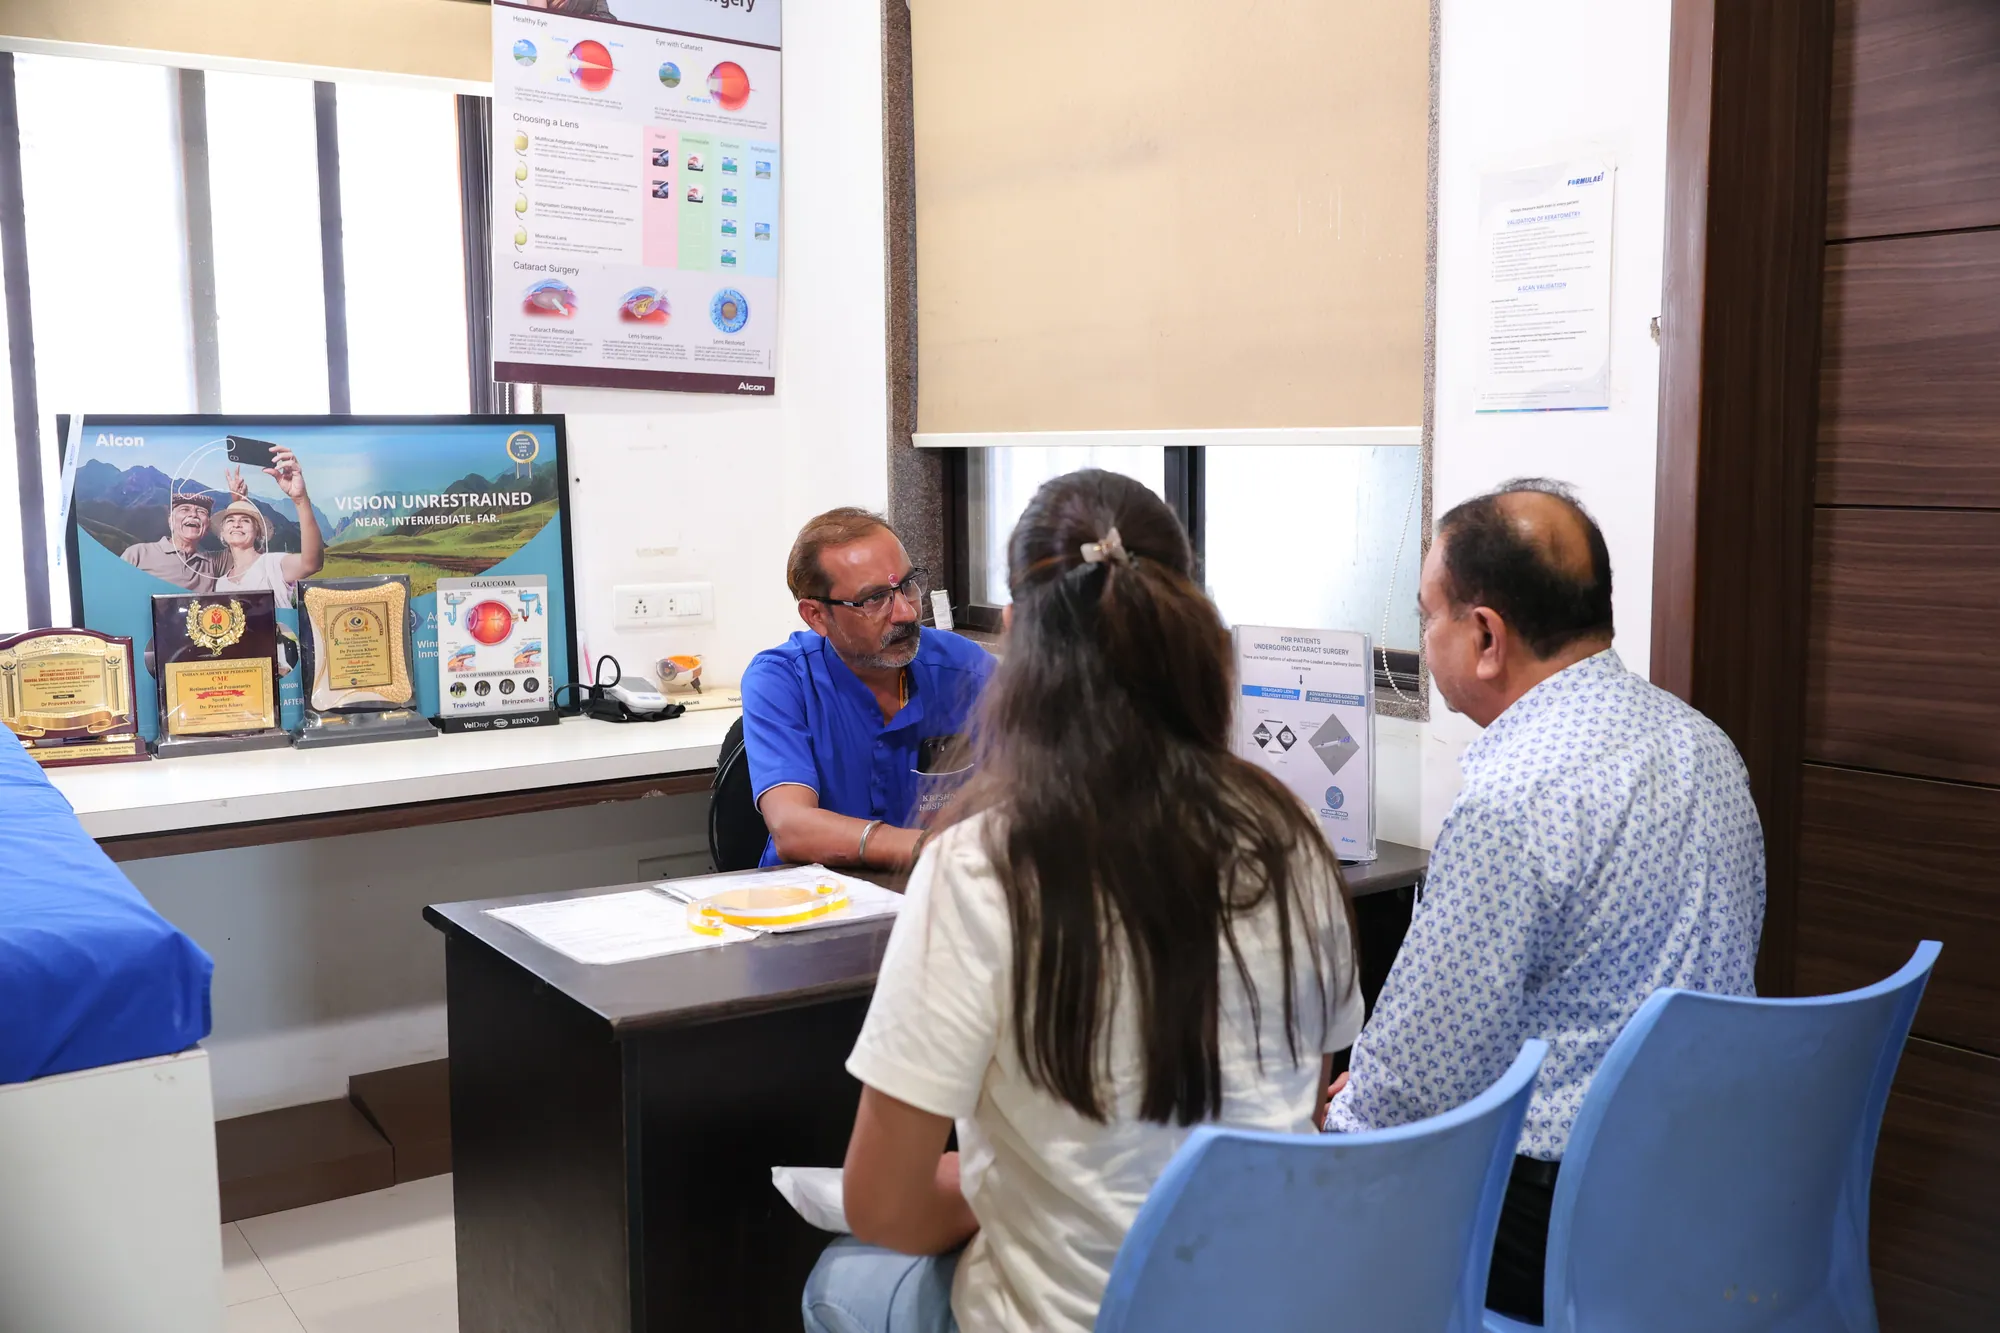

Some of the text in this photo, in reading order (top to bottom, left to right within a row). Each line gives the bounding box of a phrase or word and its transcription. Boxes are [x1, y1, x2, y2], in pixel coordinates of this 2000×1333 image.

[706, 0, 755, 13] gery
[513, 15, 548, 27] Healthy Eye
[655, 38, 667, 47] Eye
[680, 42, 703, 52] Cataract
[686, 95, 712, 104] Cataract
[513, 112, 551, 127] Choosing
[559, 119, 579, 129] Lens
[1507, 216, 1536, 225] VALIDATION
[1544, 212, 1580, 220] KERATOMETRY
[513, 261, 580, 276] Cataract Surgery
[1536, 282, 1567, 290] VALIDATION
[738, 382, 766, 392] Alcon
[96, 434, 144, 447] Alcon
[334, 492, 532, 511] VISION UNRESTRAINED
[355, 514, 500, 528] NEAR, INTERMEDIATE, FAR.
[470, 580, 516, 588] GLAUCOMA
[1254, 643, 1290, 652] UNDERGOING
[1292, 646, 1322, 654] CATARACT
[502, 697, 544, 705] Brinzemic-B
